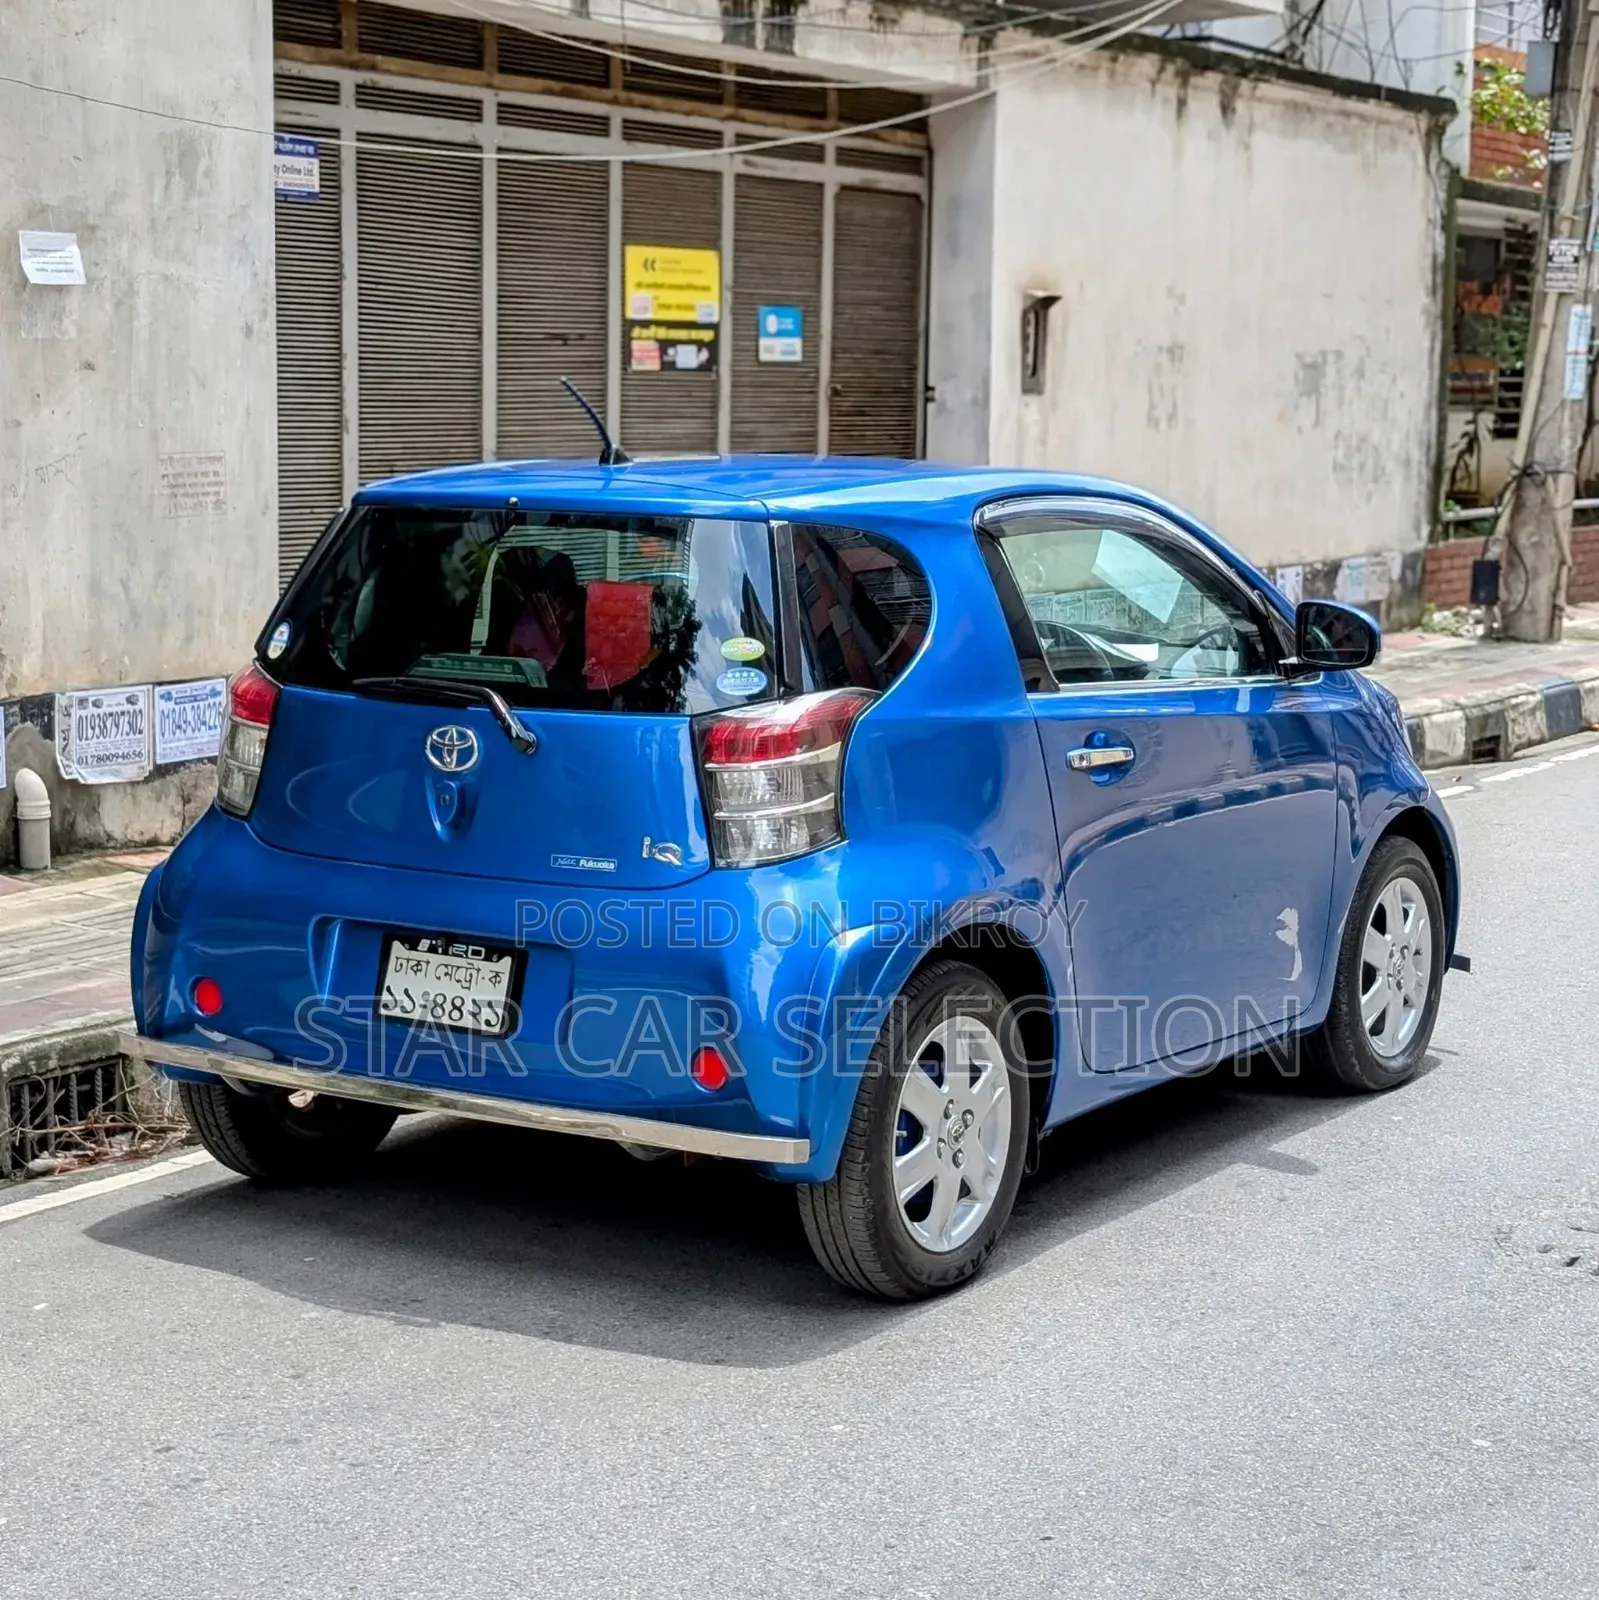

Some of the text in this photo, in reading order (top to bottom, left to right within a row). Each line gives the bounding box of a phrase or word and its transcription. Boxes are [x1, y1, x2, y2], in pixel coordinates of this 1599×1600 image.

[282, 164, 302, 176] Online
[77, 708, 144, 742] 01938797302
[77, 749, 144, 766] 01780094656
[579, 859, 615, 870] Fukuoka
[393, 955, 431, 979] ঢাকা
